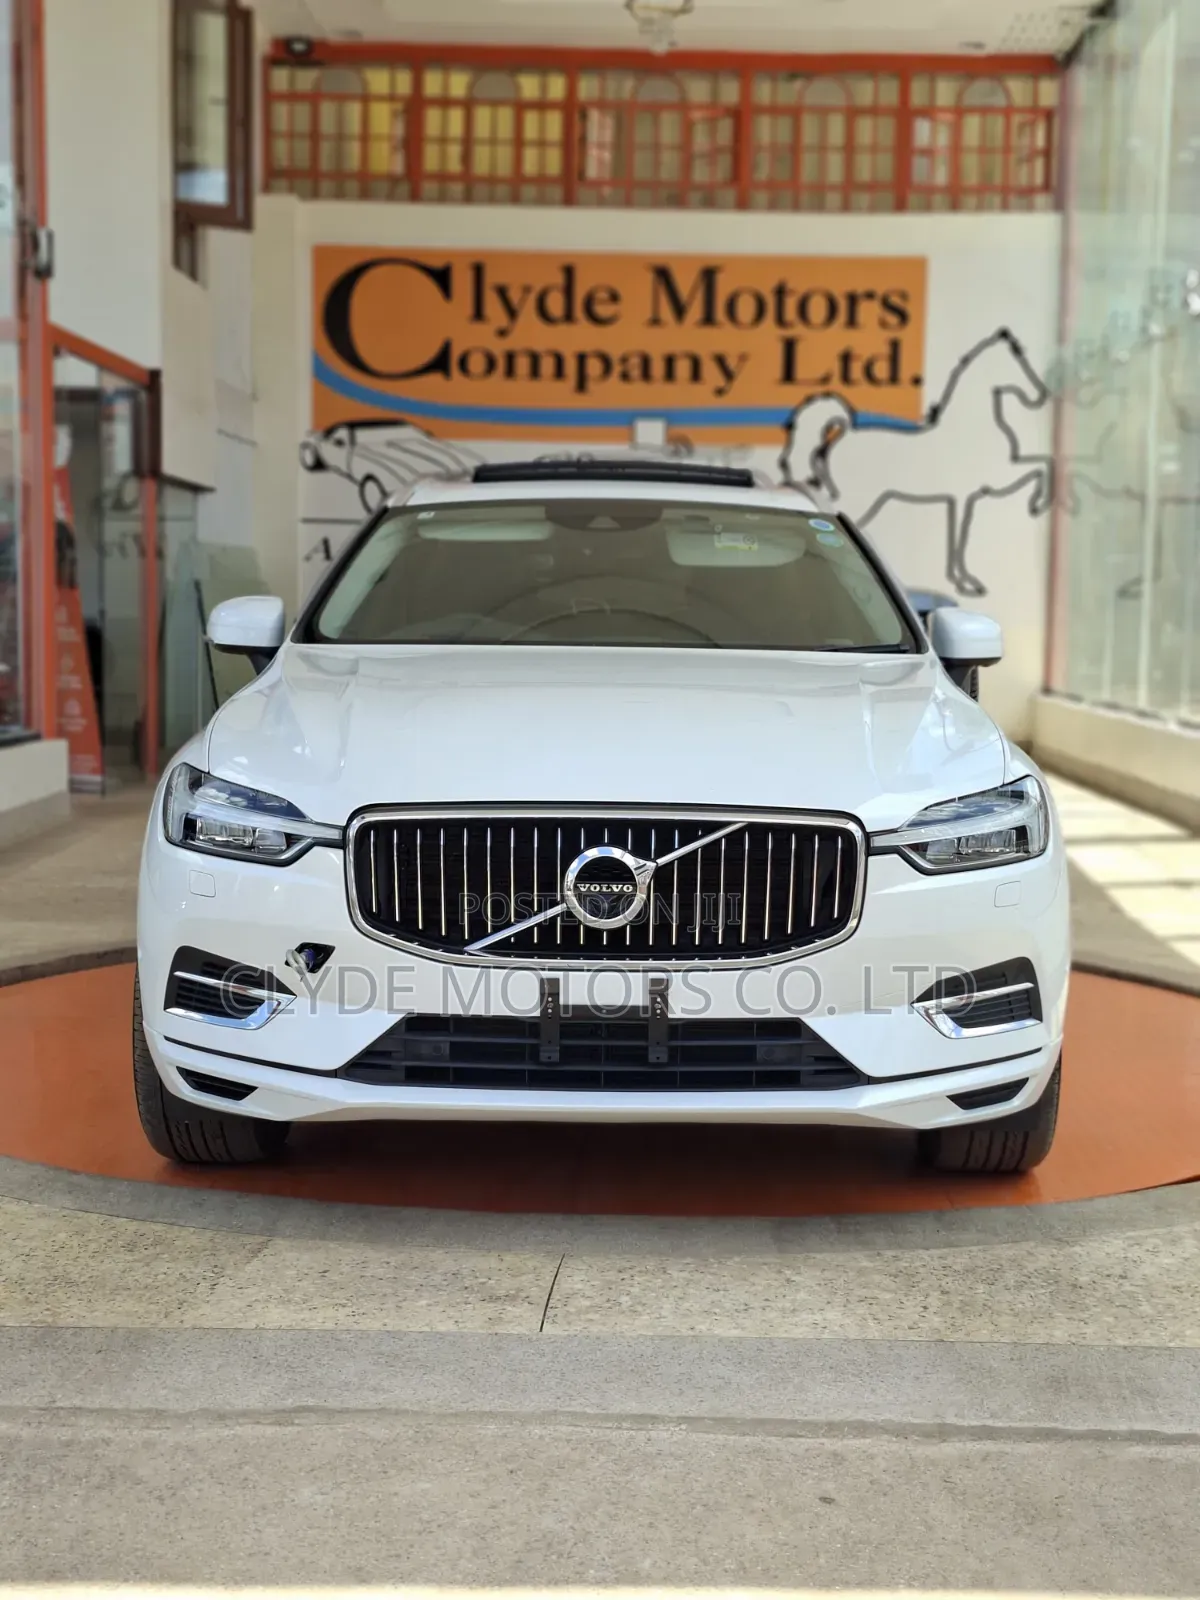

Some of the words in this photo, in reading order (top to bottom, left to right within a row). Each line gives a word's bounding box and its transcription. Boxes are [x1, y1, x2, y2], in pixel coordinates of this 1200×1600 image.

[322, 257, 622, 381] Clyde
[646, 263, 911, 331] Motors
[777, 335, 923, 388] Ltd.
[577, 883, 634, 893] VOLVO
